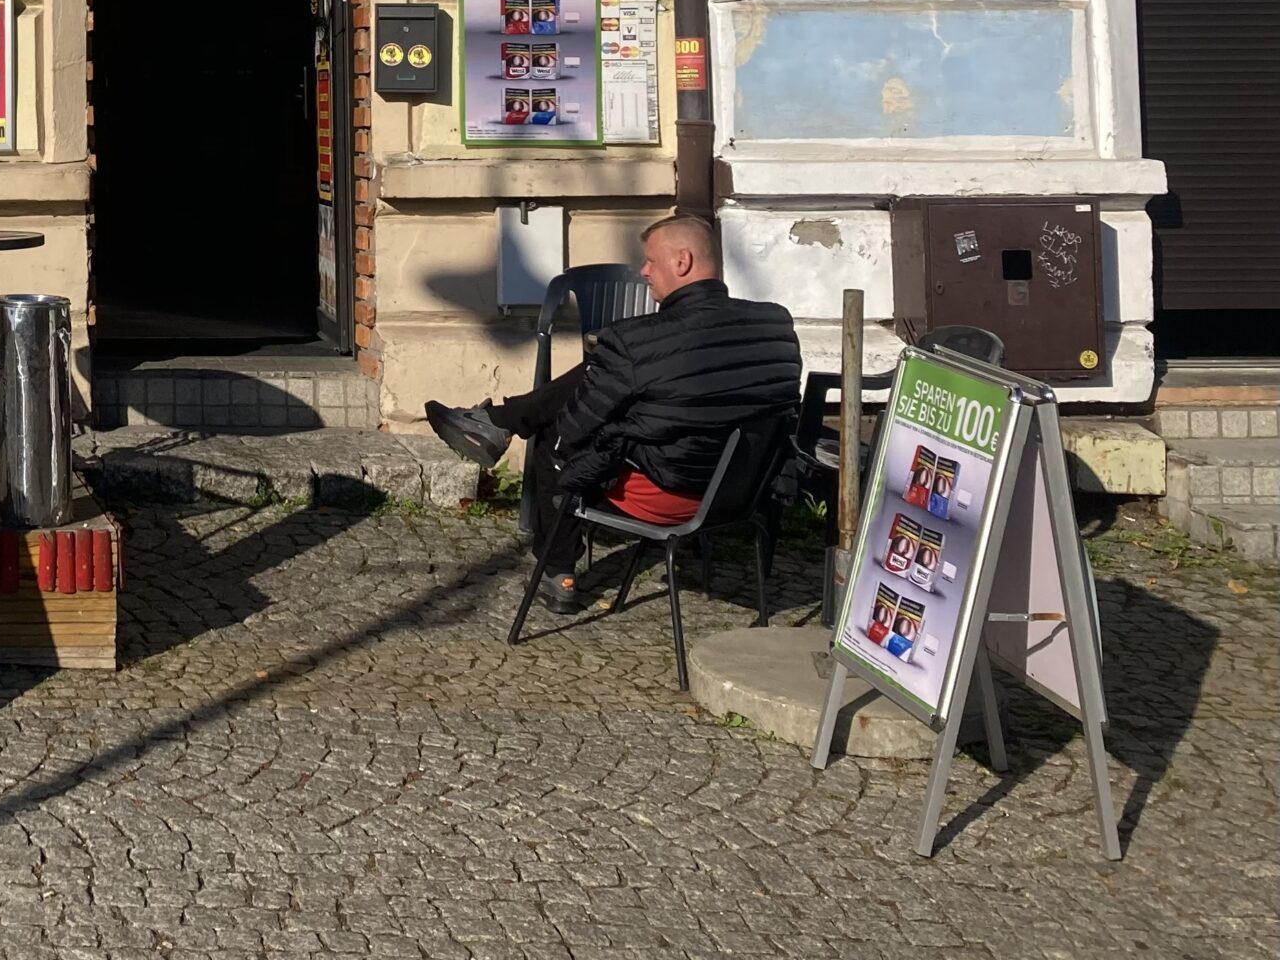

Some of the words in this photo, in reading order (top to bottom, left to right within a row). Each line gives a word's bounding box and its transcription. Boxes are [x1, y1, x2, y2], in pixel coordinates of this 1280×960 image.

[897, 395, 918, 418] SIE
[917, 402, 937, 426] BIS
[936, 410, 952, 433] ZU
[913, 379, 956, 412] SPAREN
[953, 396, 995, 448] 100
